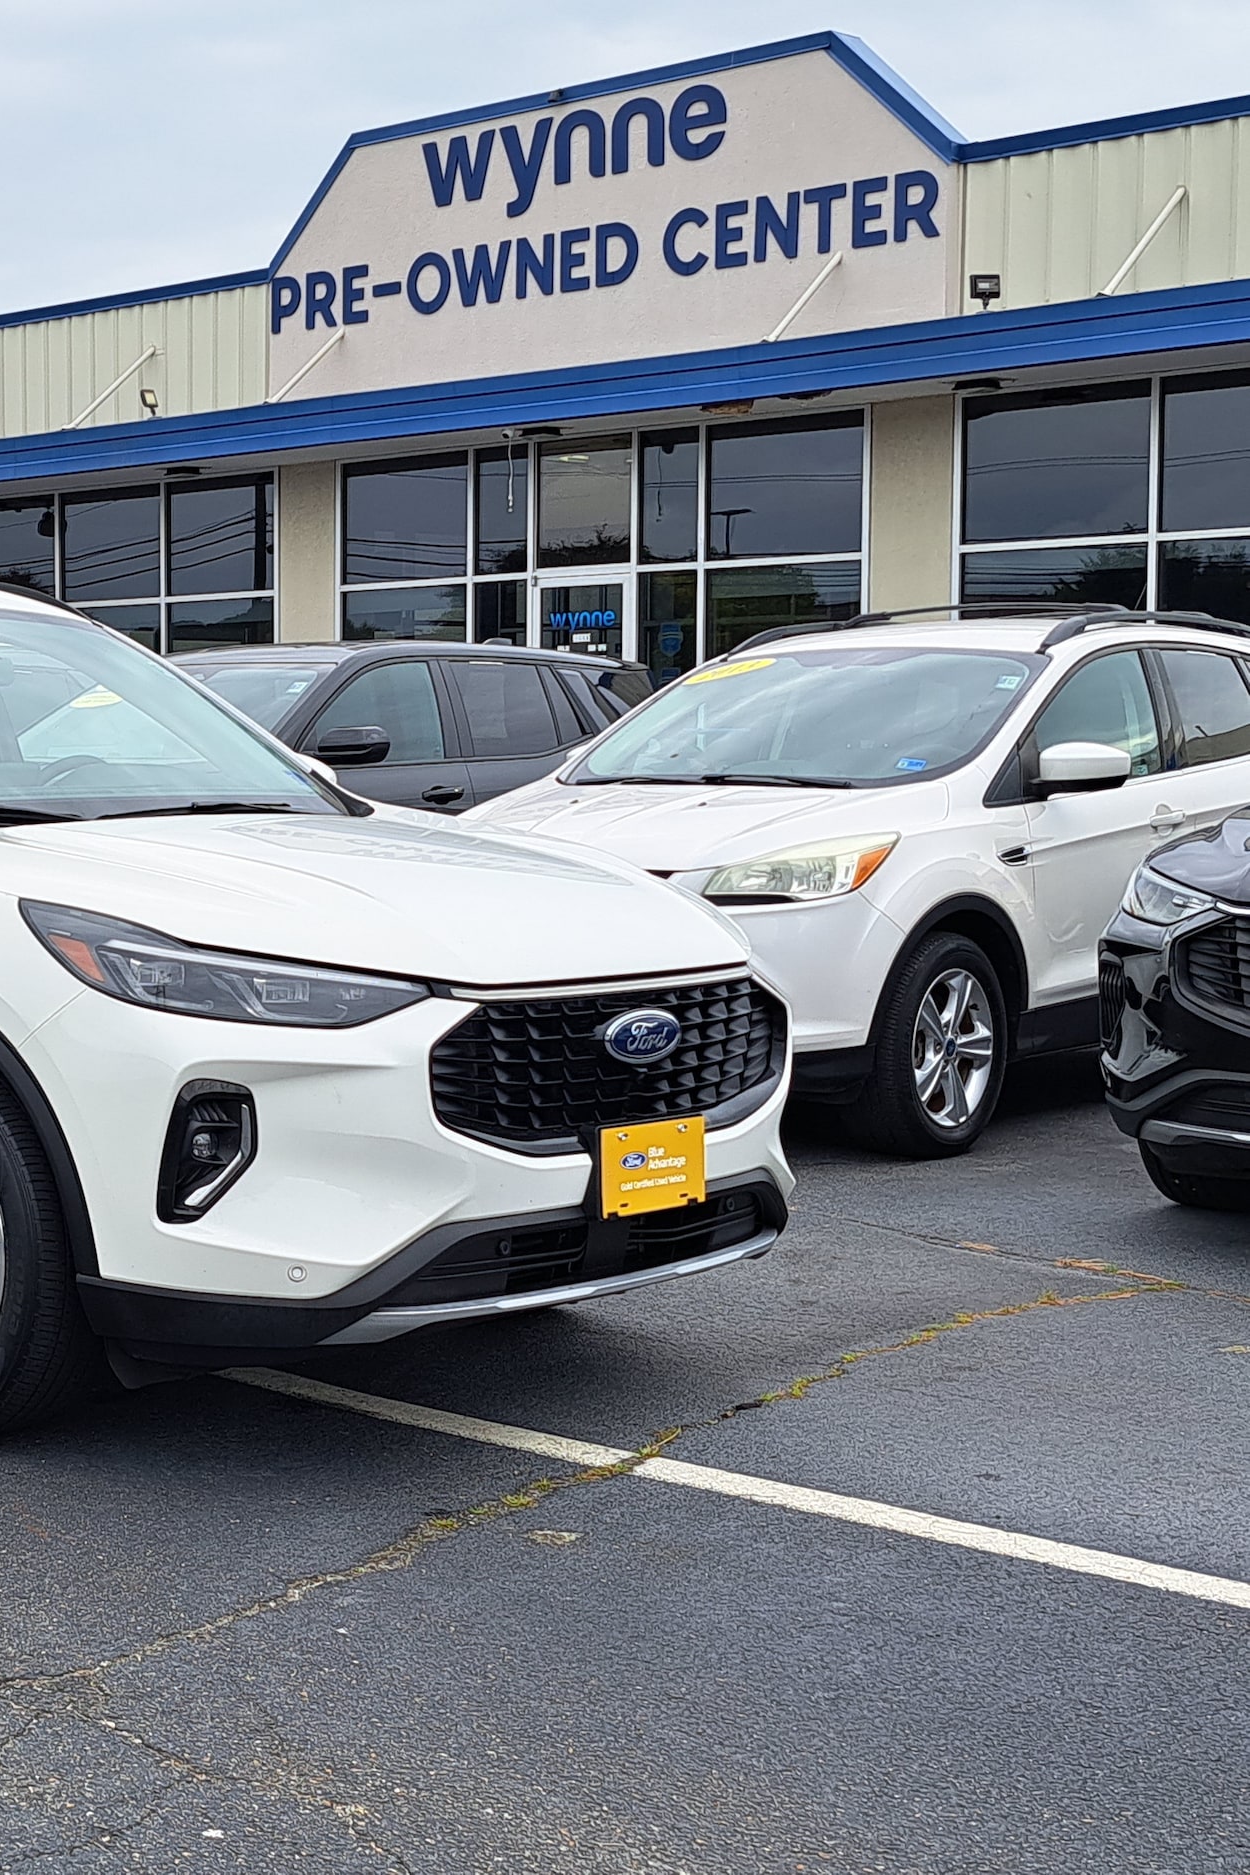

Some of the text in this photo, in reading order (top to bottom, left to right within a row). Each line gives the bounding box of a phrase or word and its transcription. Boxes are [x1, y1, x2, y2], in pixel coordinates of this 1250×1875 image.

[423, 84, 726, 217] wynne
[271, 170, 940, 333] PRE-OWNED CENTER
[550, 610, 616, 632] wynne
[626, 1022, 669, 1052] Ford
[647, 1156, 687, 1171] Advantage
[648, 1146, 665, 1158] Blue
